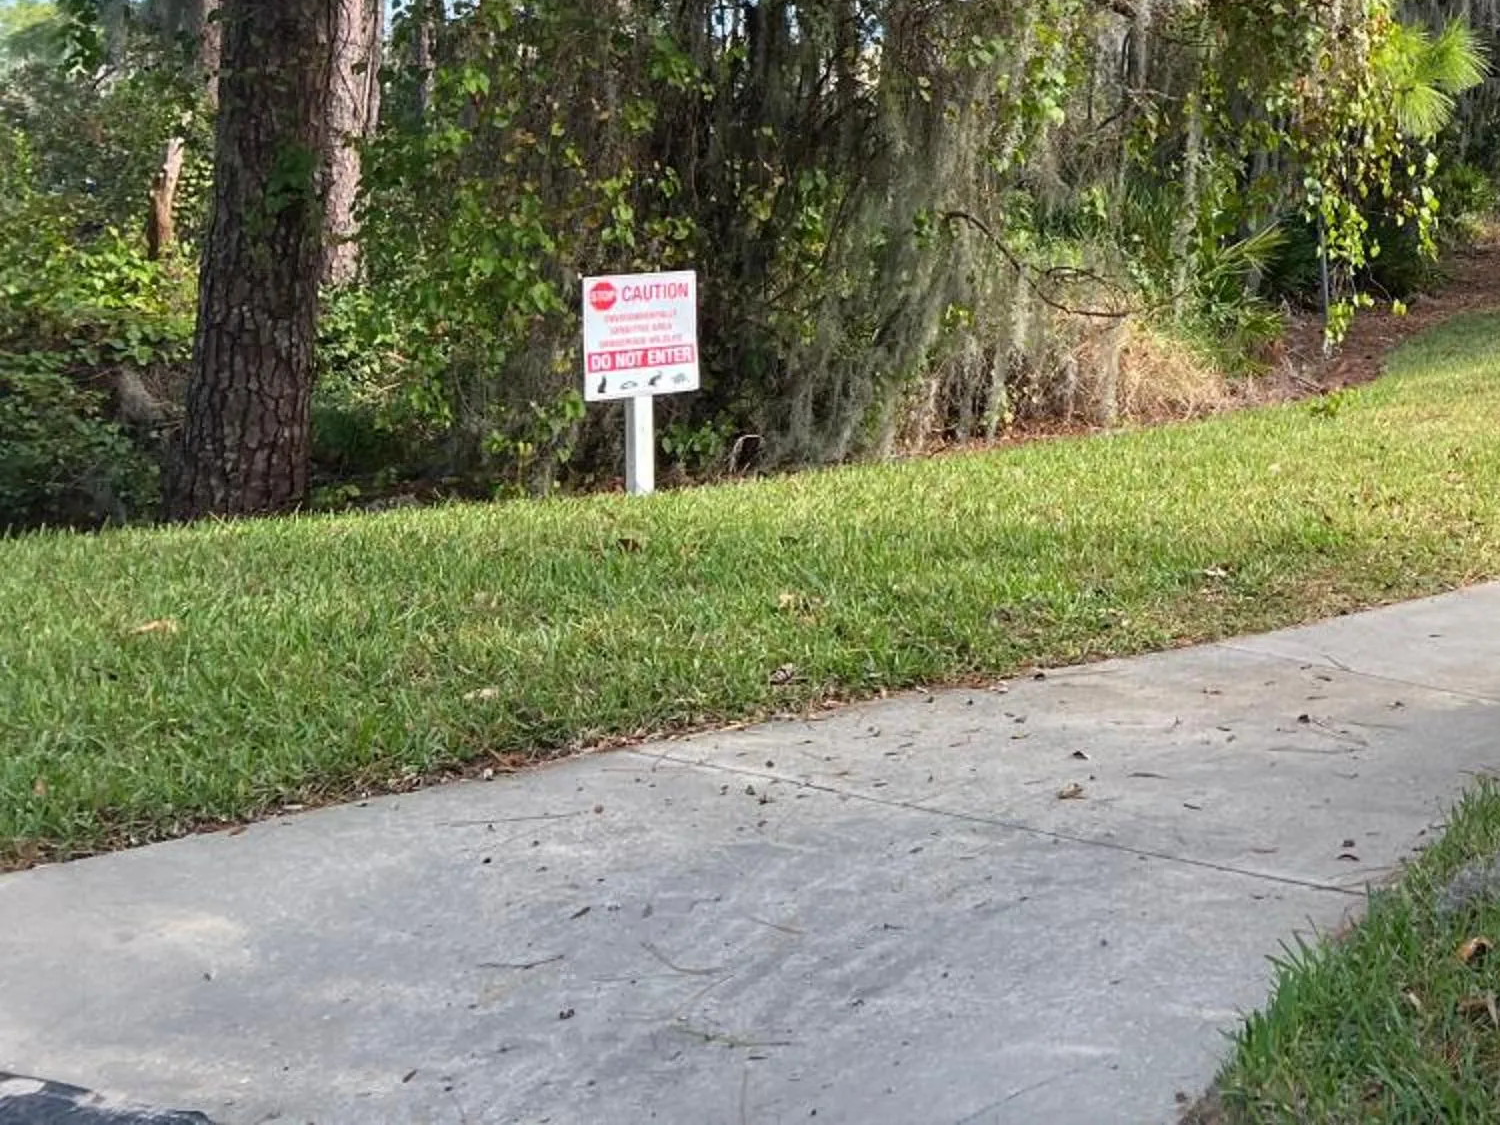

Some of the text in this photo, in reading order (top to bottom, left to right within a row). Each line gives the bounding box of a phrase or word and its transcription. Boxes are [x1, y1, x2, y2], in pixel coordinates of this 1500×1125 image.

[622, 282, 689, 302] CAUTION
[591, 346, 693, 371] DO NOT ENTER
